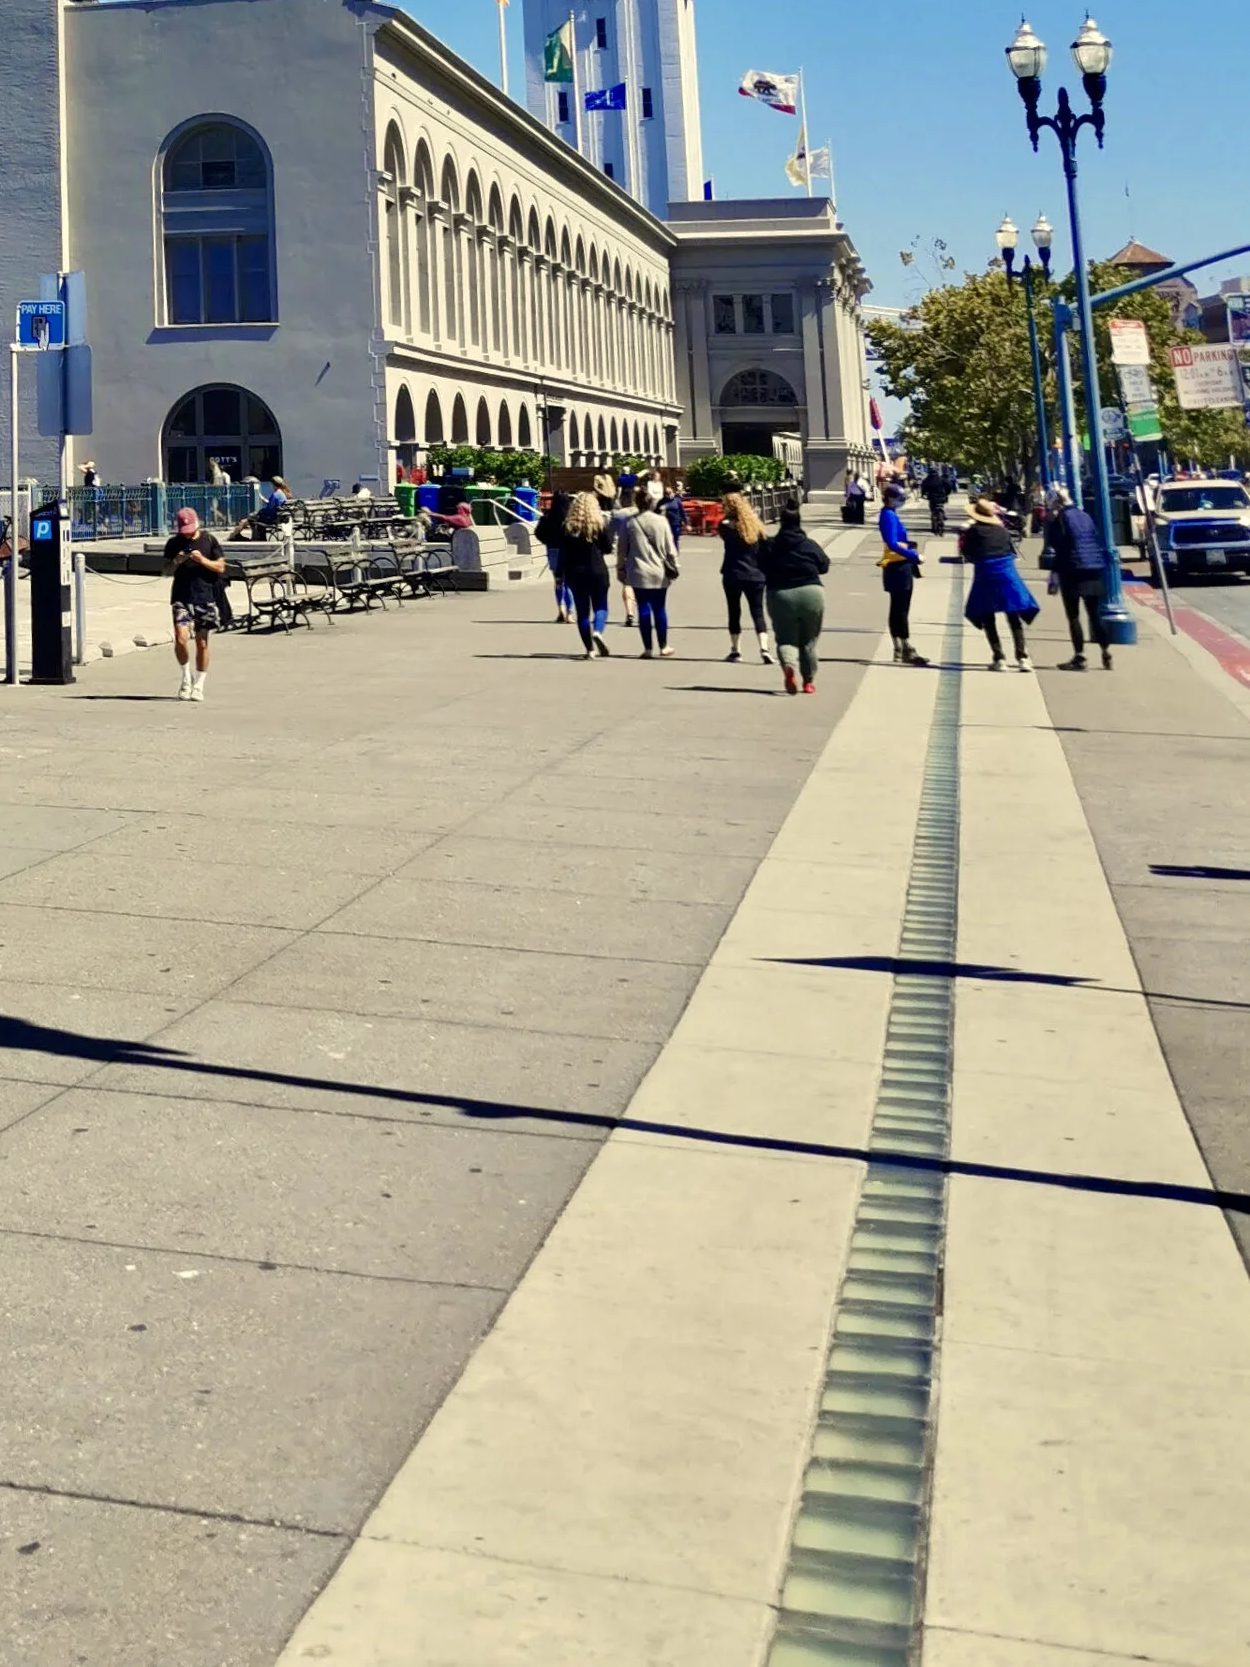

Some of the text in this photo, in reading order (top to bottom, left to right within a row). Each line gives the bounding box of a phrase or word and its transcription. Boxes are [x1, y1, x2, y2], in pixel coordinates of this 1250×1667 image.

[21, 304, 62, 315] PAY HERE
[1173, 348, 1234, 366] NO PARKING
